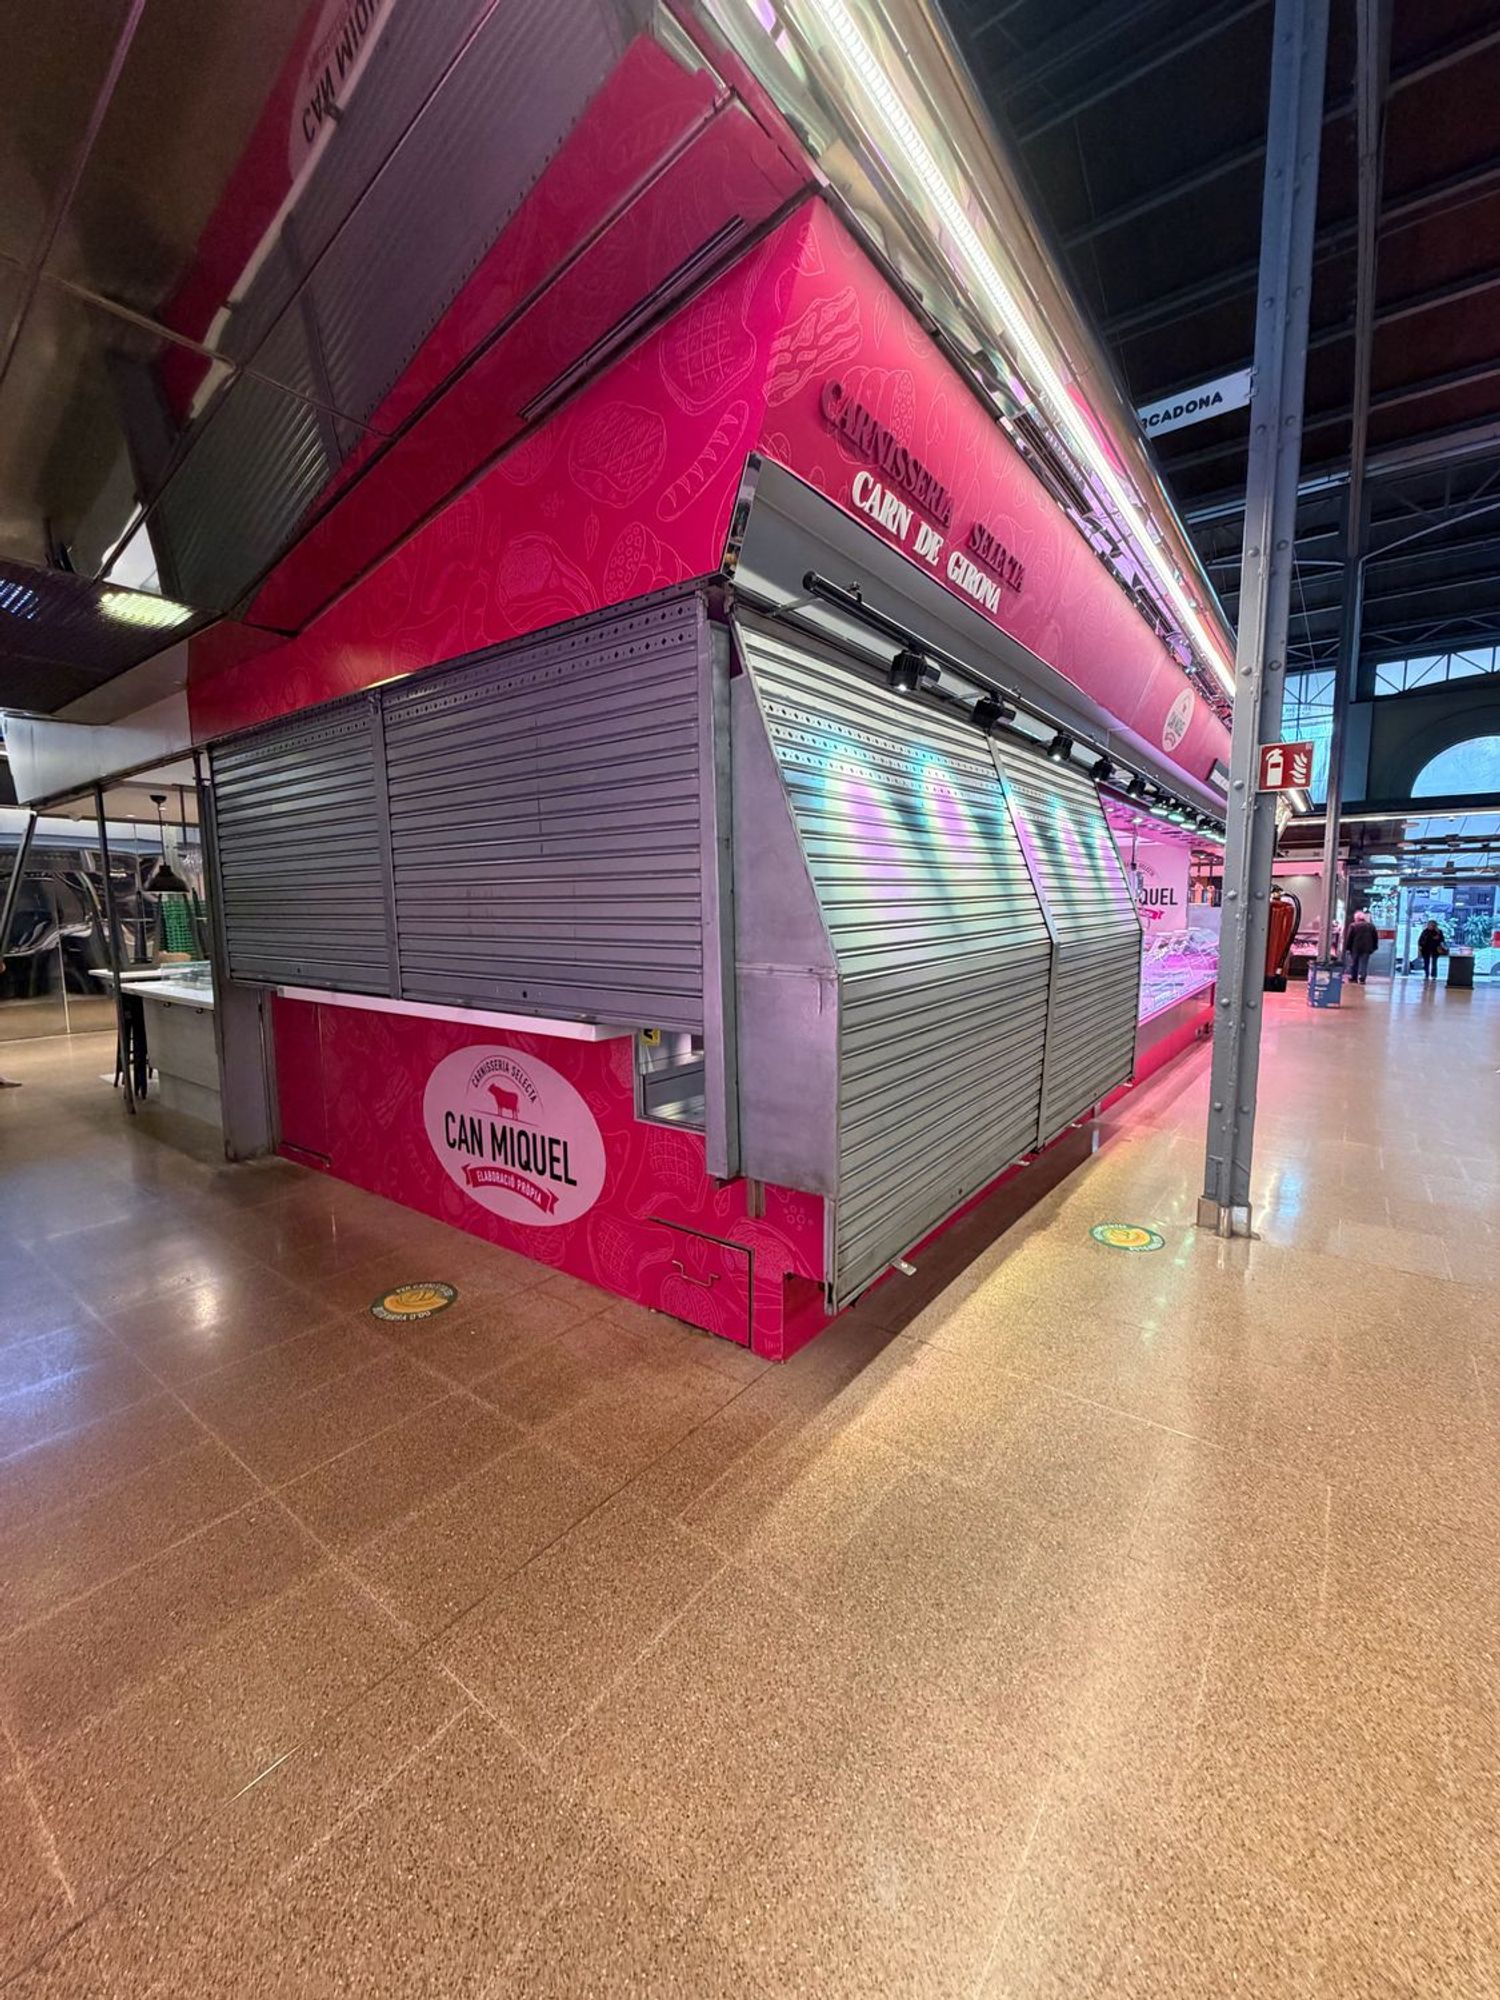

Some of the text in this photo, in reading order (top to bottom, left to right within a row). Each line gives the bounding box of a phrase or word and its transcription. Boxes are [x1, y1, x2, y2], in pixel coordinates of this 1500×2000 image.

[820, 378, 1025, 592] CARNISSERIA SELECTA
[852, 471, 1001, 614] CARN DE GIRONA
[1134, 888, 1178, 905] QUEL
[471, 1059, 537, 1103] CARNISSERIA SELECTA
[444, 1110, 577, 1187] CAN MIQUEL
